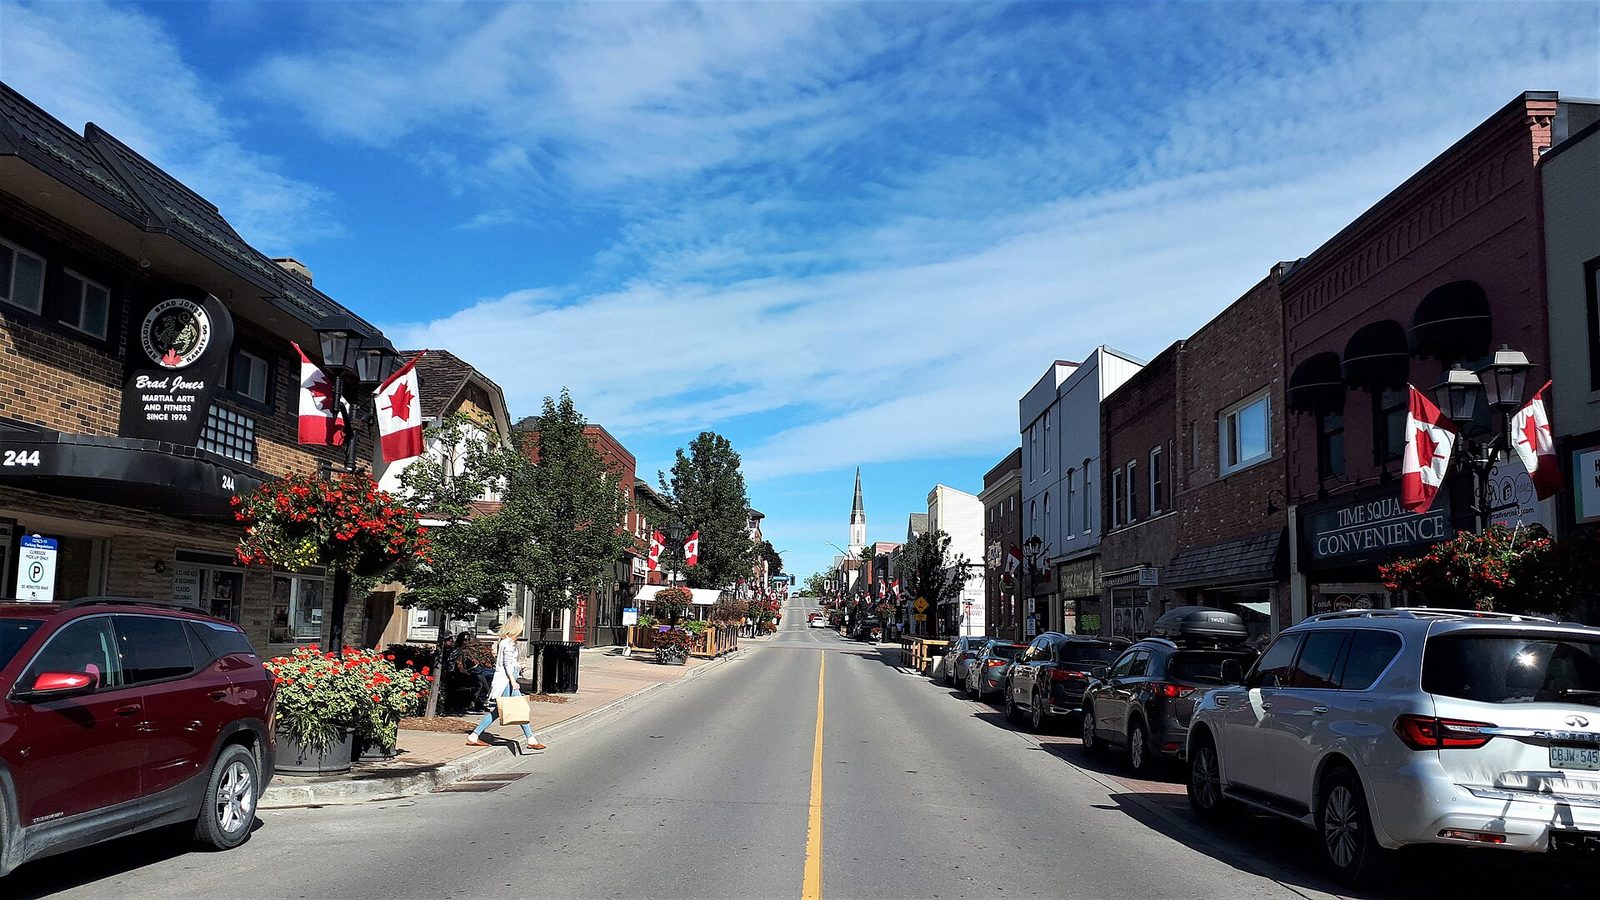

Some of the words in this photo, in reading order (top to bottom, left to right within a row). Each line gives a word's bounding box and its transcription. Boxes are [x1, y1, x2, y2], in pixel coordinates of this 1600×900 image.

[155, 301, 176, 313] BRAD
[179, 301, 203, 317] JONES
[143, 319, 158, 360] SHOTOKAN
[136, 375, 169, 389] Brad
[169, 375, 204, 393] Jones
[142, 394, 174, 402] MARTIAL
[143, 403, 161, 411] AND
[163, 404, 192, 412] FITNESS
[146, 413, 168, 421] SINCE
[171, 413, 187, 421] 1976
[3, 450, 40, 466] 244
[221, 474, 235, 491] 244
[1337, 505, 1365, 527] TIME
[1367, 497, 1409, 521] SQUA
[1317, 515, 1445, 556] CONVENIENCE
[33, 565, 41, 579] P
[1580, 750, 1598, 764] 545
